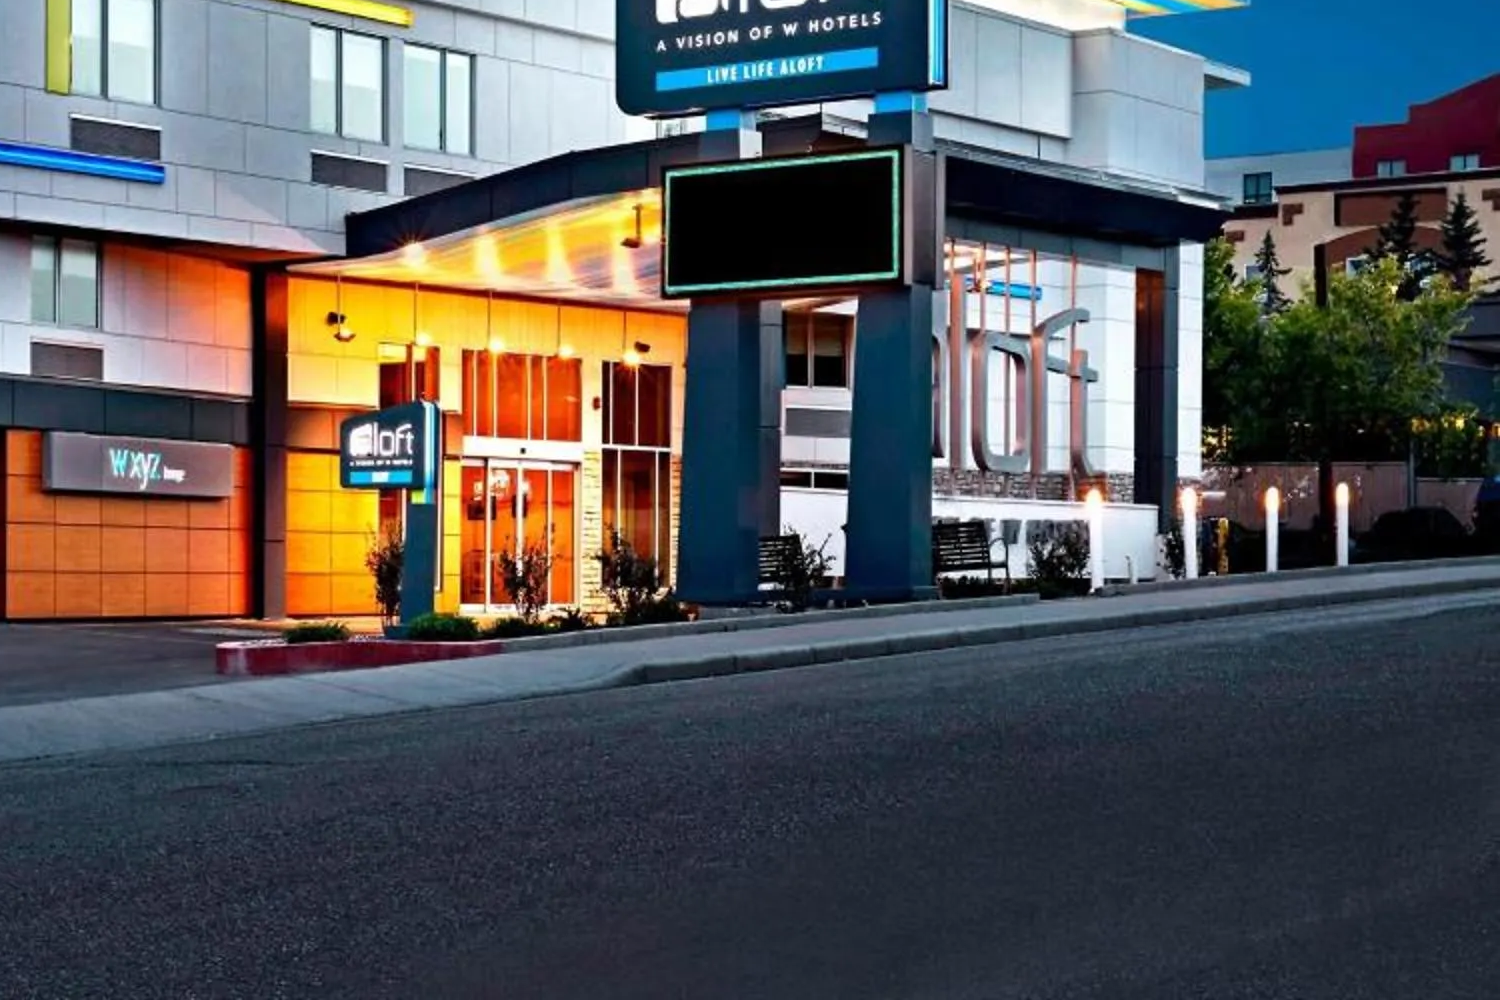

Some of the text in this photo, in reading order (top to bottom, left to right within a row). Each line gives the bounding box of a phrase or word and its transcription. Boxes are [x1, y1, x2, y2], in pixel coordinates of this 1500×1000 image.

[656, 11, 882, 52] A VISION OF W HOTELS
[706, 56, 825, 84] LIVE LIFE ALOFT
[932, 273, 1098, 477] loft
